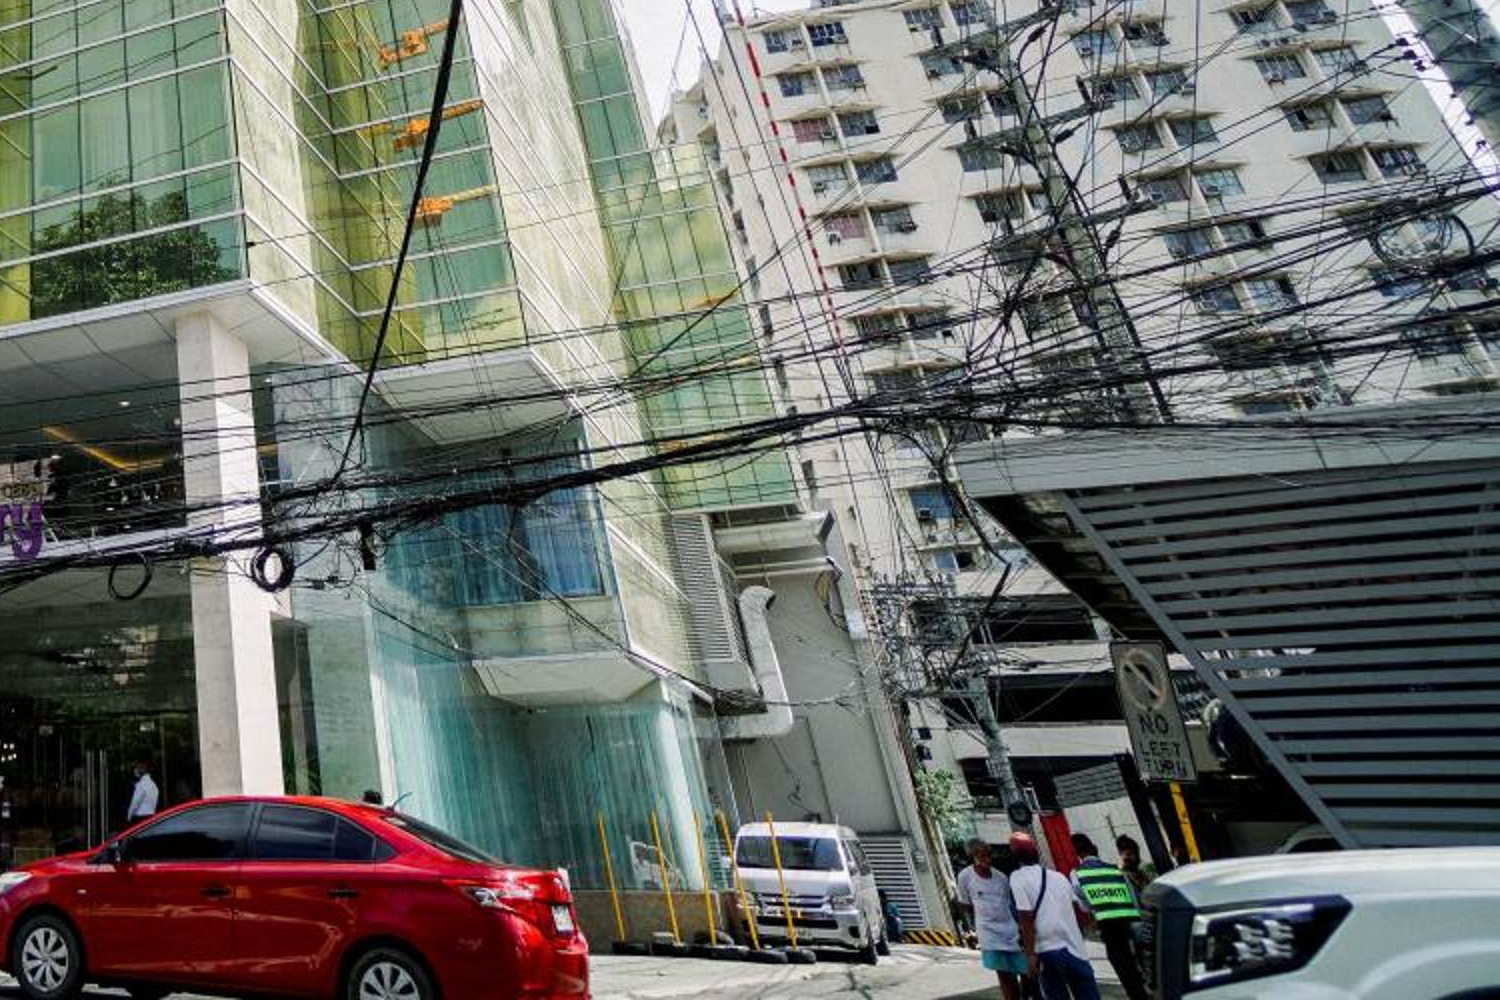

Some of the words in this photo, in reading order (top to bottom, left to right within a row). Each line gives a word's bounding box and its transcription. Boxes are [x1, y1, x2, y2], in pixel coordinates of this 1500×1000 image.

[1139, 713, 1169, 735] NO
[1141, 740, 1182, 755] LEFT
[1143, 757, 1188, 777] TURN
[1087, 884, 1128, 900] SECURITY
